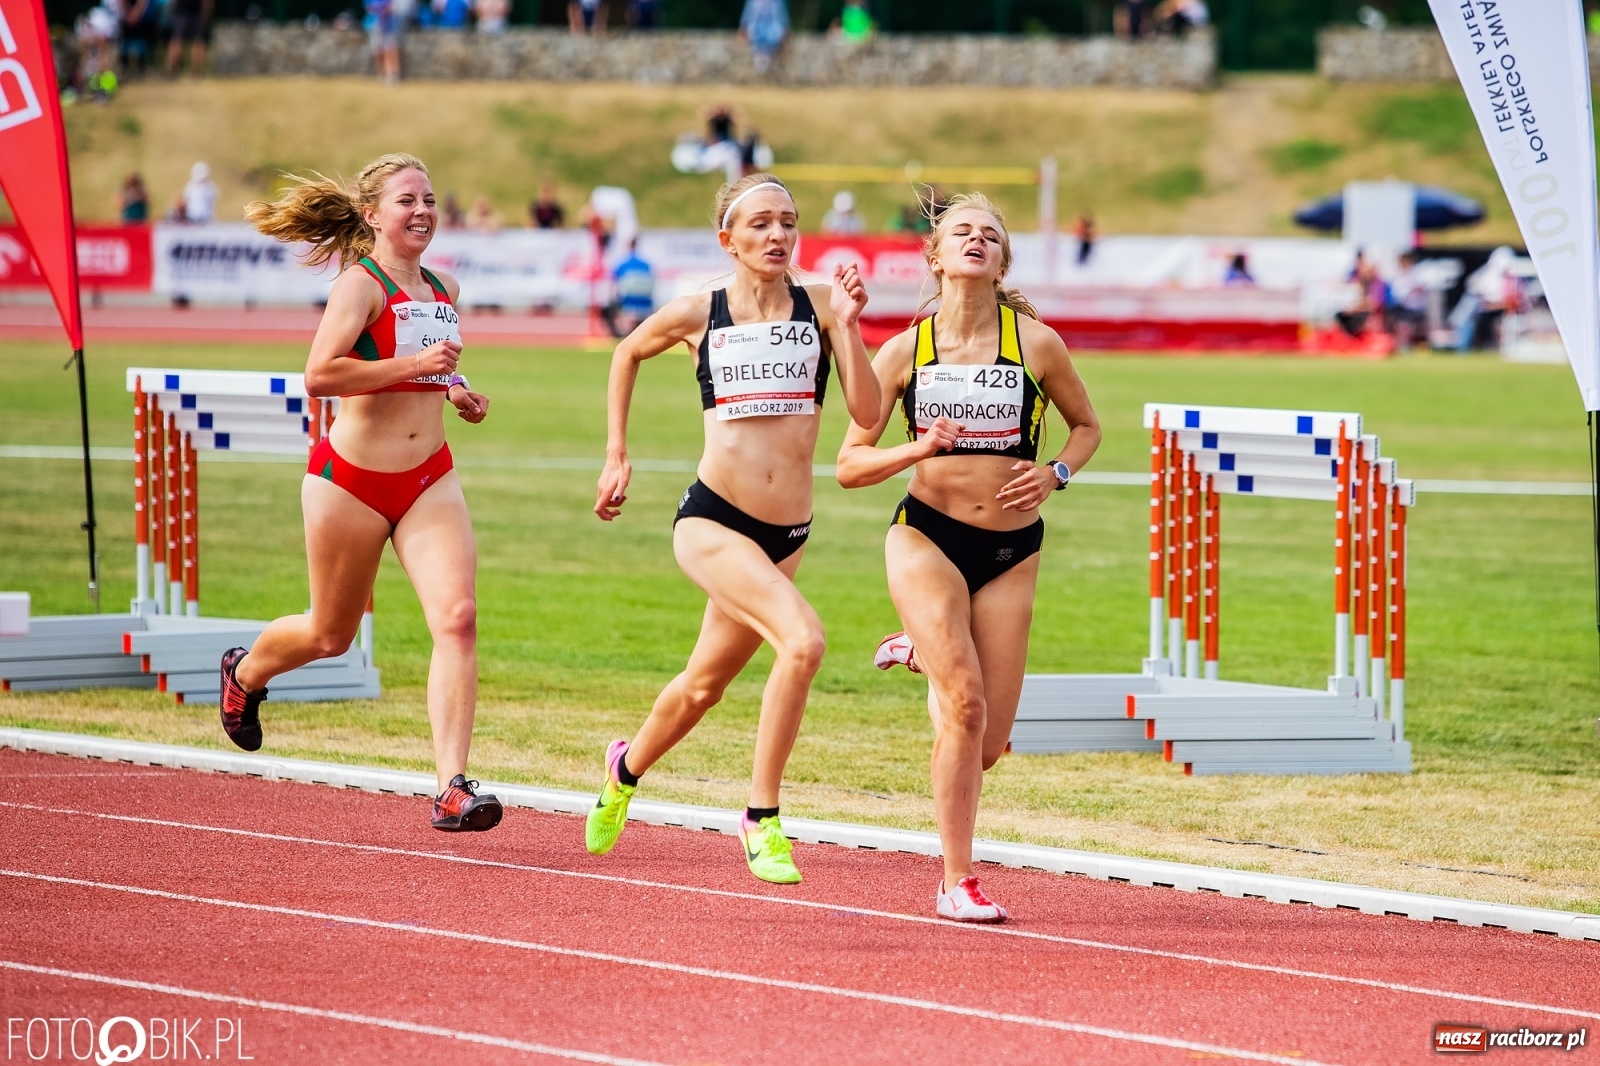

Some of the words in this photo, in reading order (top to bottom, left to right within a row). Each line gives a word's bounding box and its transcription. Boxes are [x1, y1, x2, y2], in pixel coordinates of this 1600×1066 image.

[769, 325, 814, 346] 546
[722, 362, 809, 383] BIELECKA
[973, 368, 1019, 389] 428
[727, 401, 781, 416] RACIBÓRZ
[783, 402, 804, 413] 2019
[918, 401, 1018, 420] KONDRACKA
